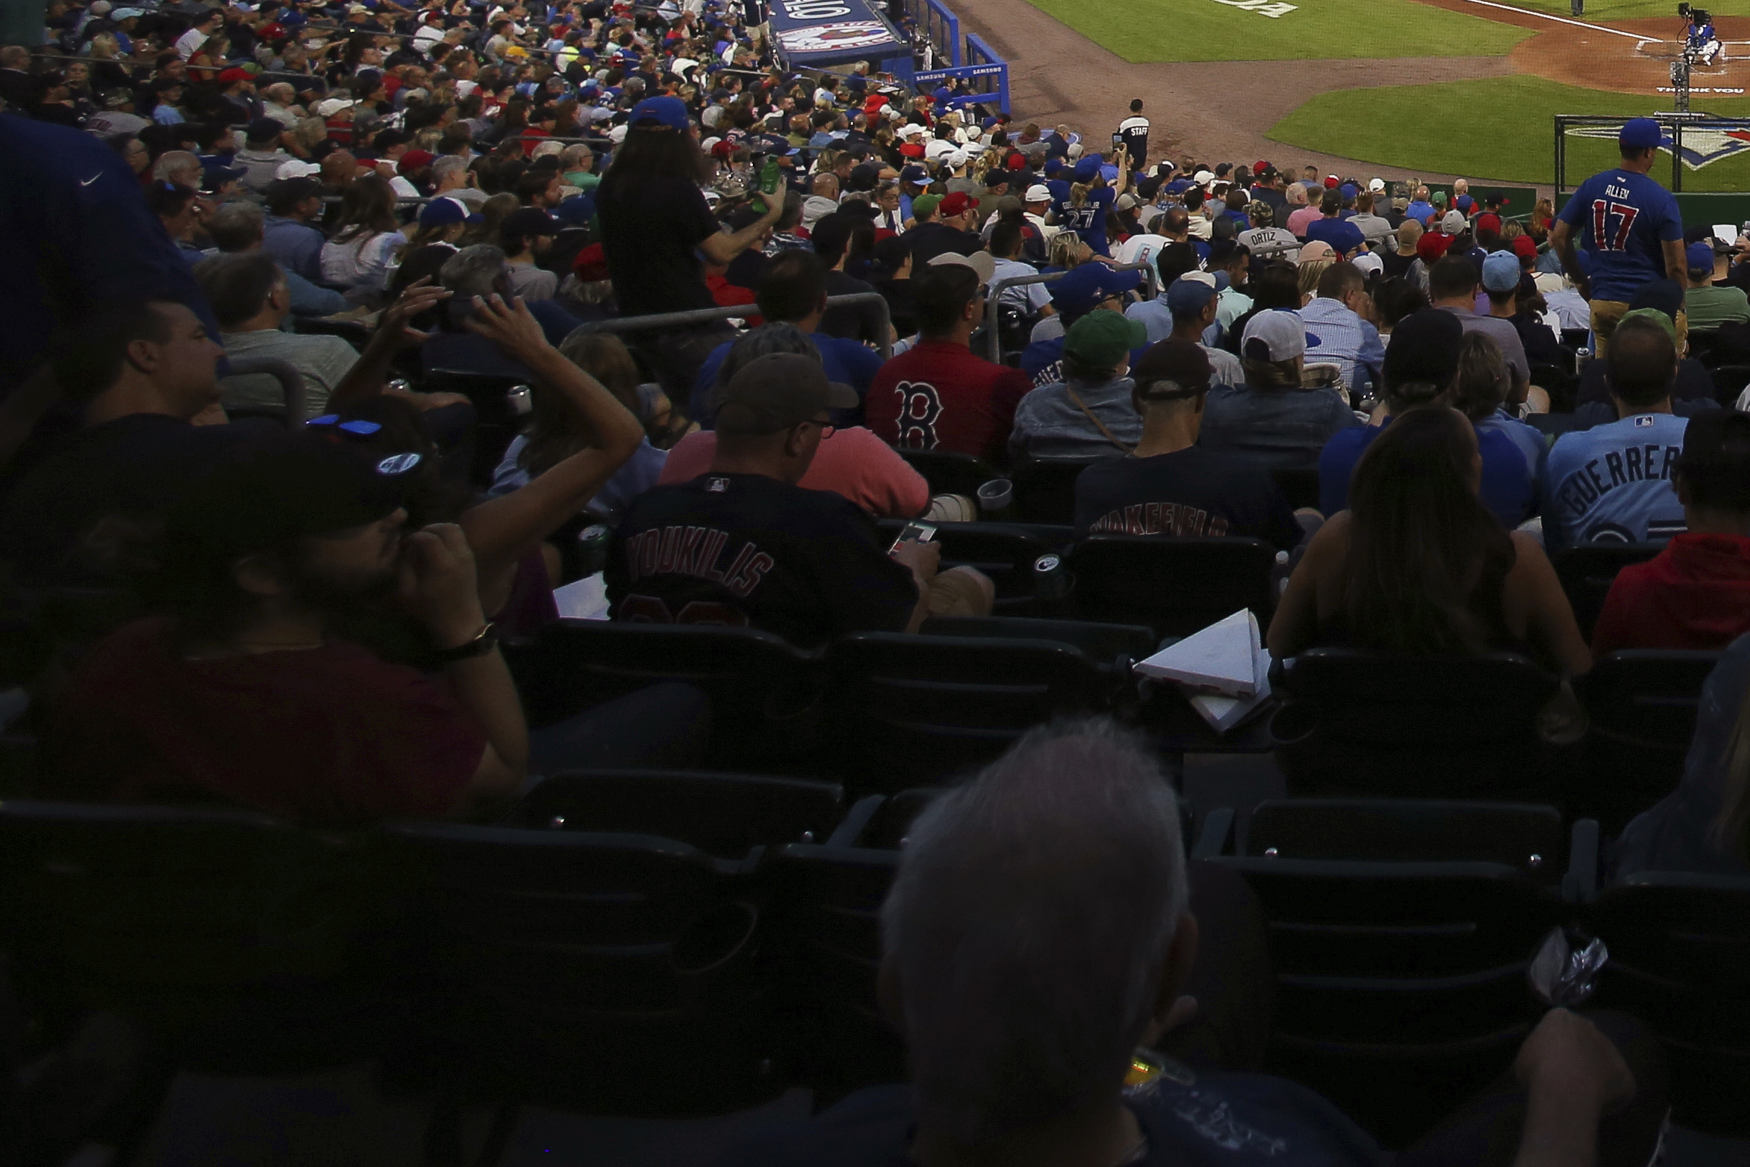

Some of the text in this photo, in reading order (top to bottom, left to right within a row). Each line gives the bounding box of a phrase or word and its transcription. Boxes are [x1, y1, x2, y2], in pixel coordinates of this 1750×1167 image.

[916, 72, 946, 81] SAMSUNG
[972, 66, 1002, 76] SAMSUNG
[1130, 127, 1148, 136] STAFF
[1604, 184, 1630, 200] ALLEN
[1066, 210, 1097, 230] 27
[1592, 199, 1640, 252] 17
[1250, 231, 1276, 246] ORTIZ
[895, 380, 945, 451] B
[1560, 444, 1683, 517] GUERRER
[626, 525, 774, 598] YOUKILIS
